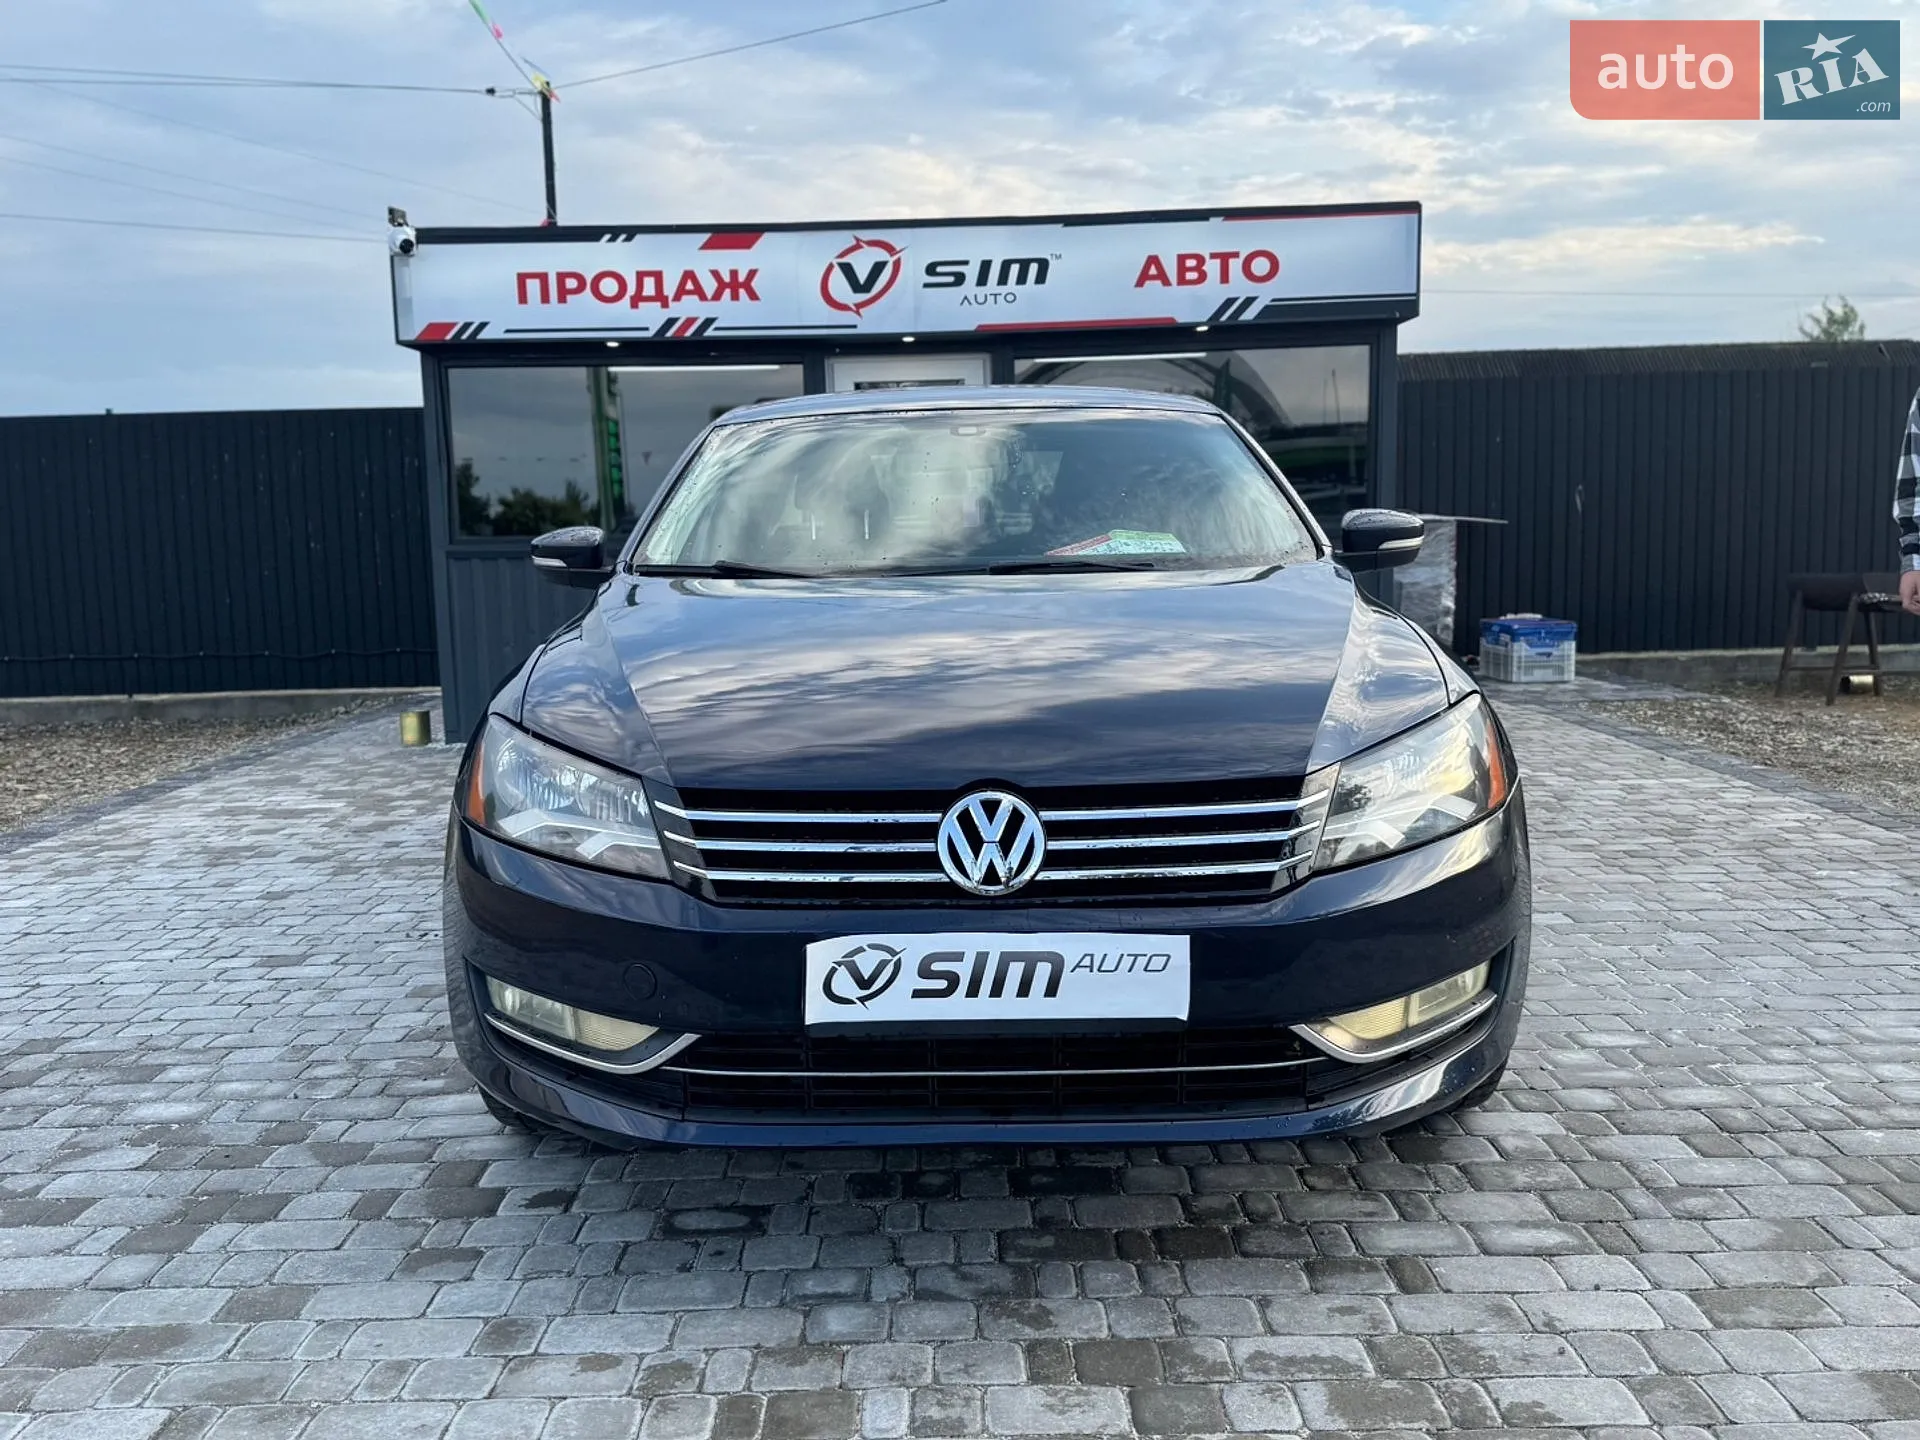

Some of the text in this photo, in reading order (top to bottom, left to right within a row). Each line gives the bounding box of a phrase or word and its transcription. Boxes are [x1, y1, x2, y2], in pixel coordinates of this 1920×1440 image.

[922, 256, 1051, 289] SIM
[1134, 249, 1280, 288] АВТО
[516, 269, 760, 309] ПРОДАЖ
[959, 292, 1017, 306] AUTO
[911, 950, 1065, 999] SIM
[1070, 953, 1172, 973] AUTO
